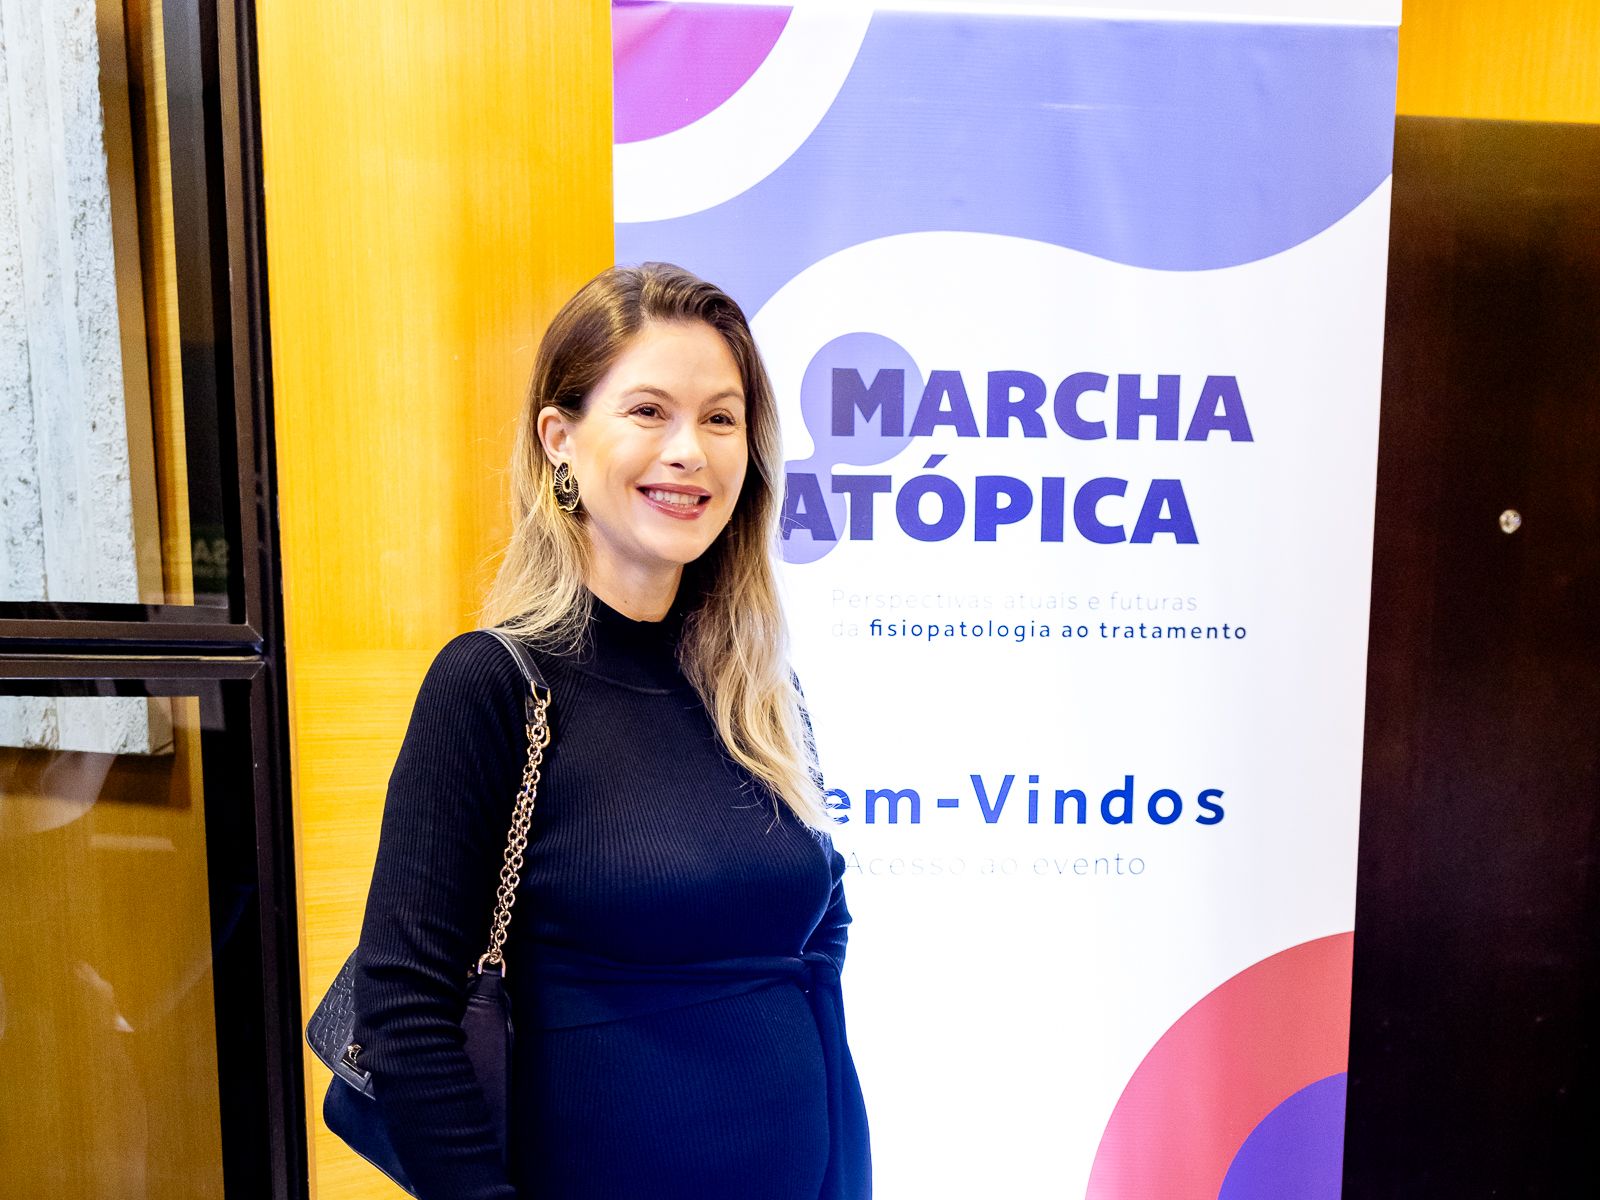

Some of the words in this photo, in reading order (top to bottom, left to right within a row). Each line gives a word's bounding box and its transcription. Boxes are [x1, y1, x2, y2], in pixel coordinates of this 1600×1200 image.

[831, 367, 1255, 442] MARCHA
[779, 453, 1200, 545] ATÓPICA
[831, 589, 993, 612] Perspectivas
[1004, 591, 1078, 611] atuais
[1087, 596, 1100, 611] e
[1110, 590, 1199, 612] futuras
[869, 618, 1051, 643] fisiopatologia
[1061, 622, 1089, 639] ao
[1099, 621, 1247, 641] tratamento
[823, 774, 1226, 826] em-Vindos
[1032, 852, 1146, 876] evento
